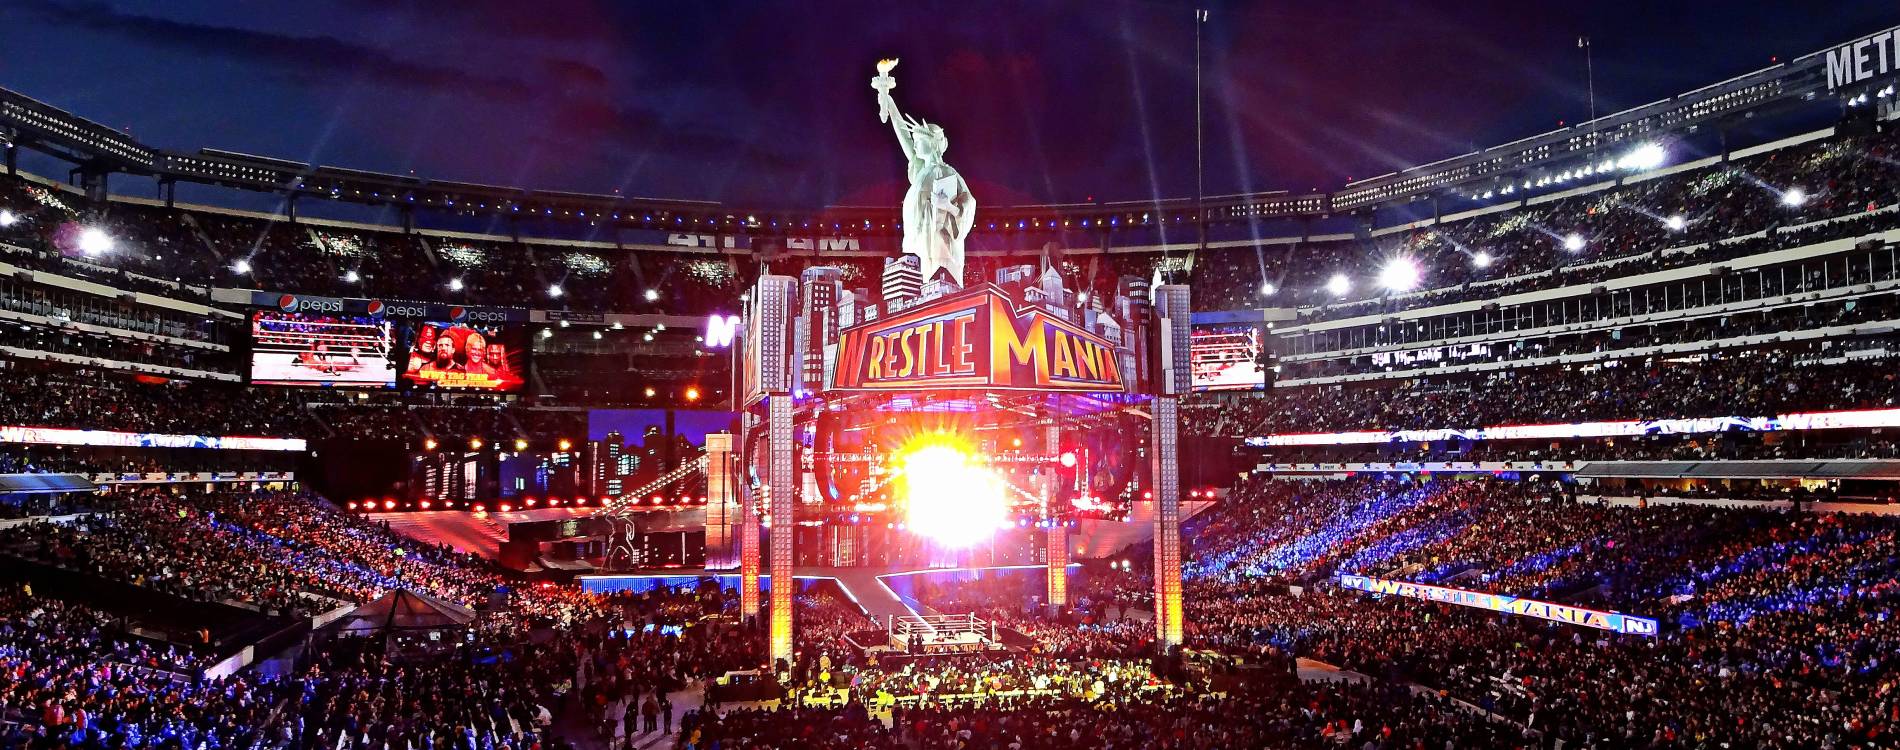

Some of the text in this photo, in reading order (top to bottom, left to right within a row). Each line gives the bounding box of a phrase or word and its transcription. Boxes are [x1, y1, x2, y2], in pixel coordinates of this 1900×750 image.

[301, 297, 343, 313] pepsi
[386, 303, 426, 319] pepsi
[468, 309, 507, 324] pepsi
[1343, 577, 1363, 589] NY
[1626, 619, 1653, 633] NJ
